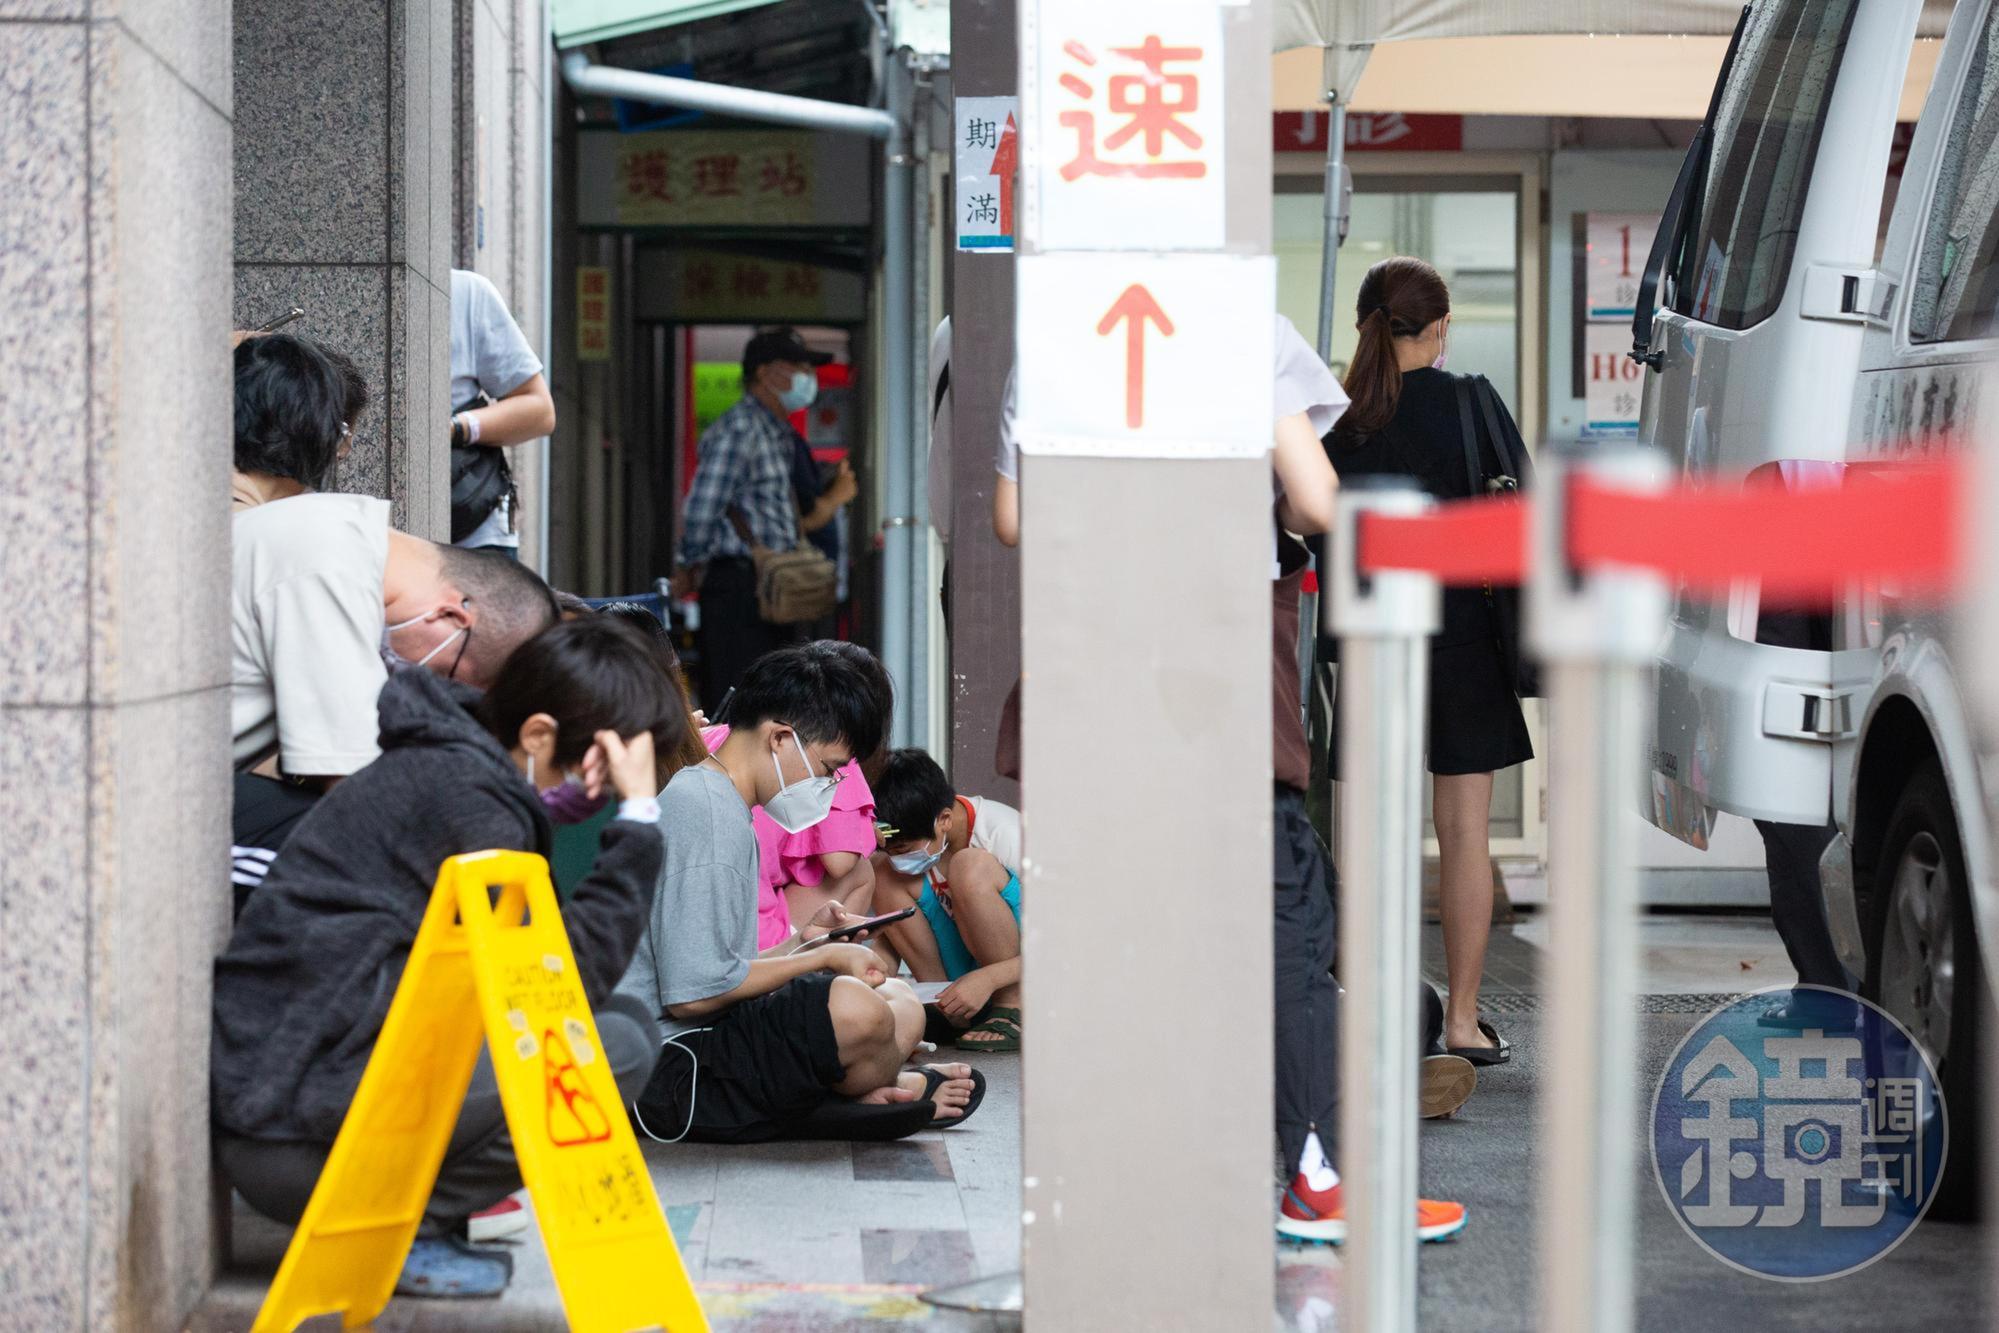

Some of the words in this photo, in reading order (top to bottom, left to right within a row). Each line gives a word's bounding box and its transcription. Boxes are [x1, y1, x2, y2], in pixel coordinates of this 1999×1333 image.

[1058, 34, 1207, 183] 速
[622, 150, 808, 203] 護理站
[1617, 225, 1632, 276] 1
[1591, 353, 1640, 382] H6
